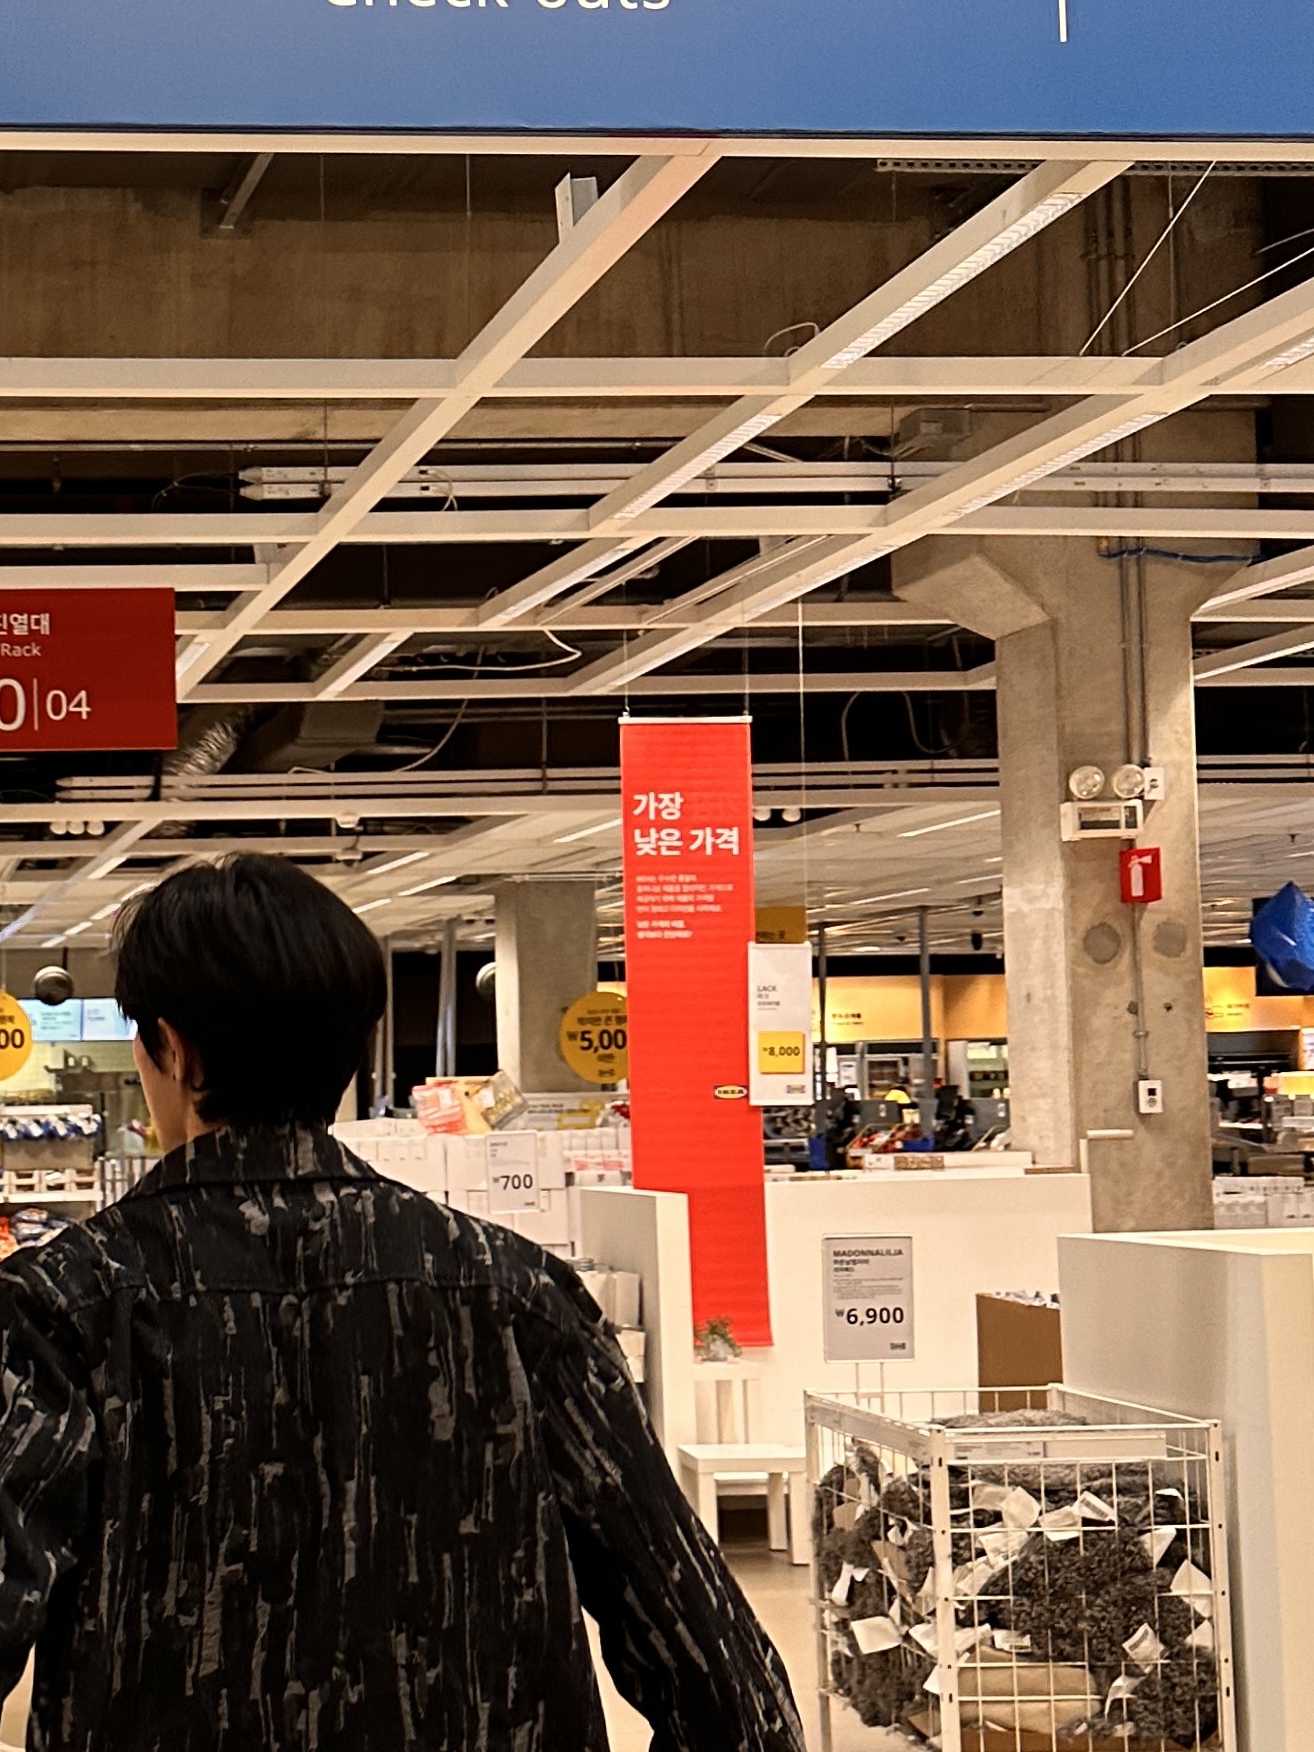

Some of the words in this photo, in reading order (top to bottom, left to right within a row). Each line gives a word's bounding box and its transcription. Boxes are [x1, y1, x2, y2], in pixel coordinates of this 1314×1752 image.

[0, 642, 42, 657] Rack
[632, 791, 684, 821] 가장
[633, 827, 683, 856] 낮은
[688, 826, 740, 856] 가격
[832, 1249, 904, 1258] MADONNALILJA
